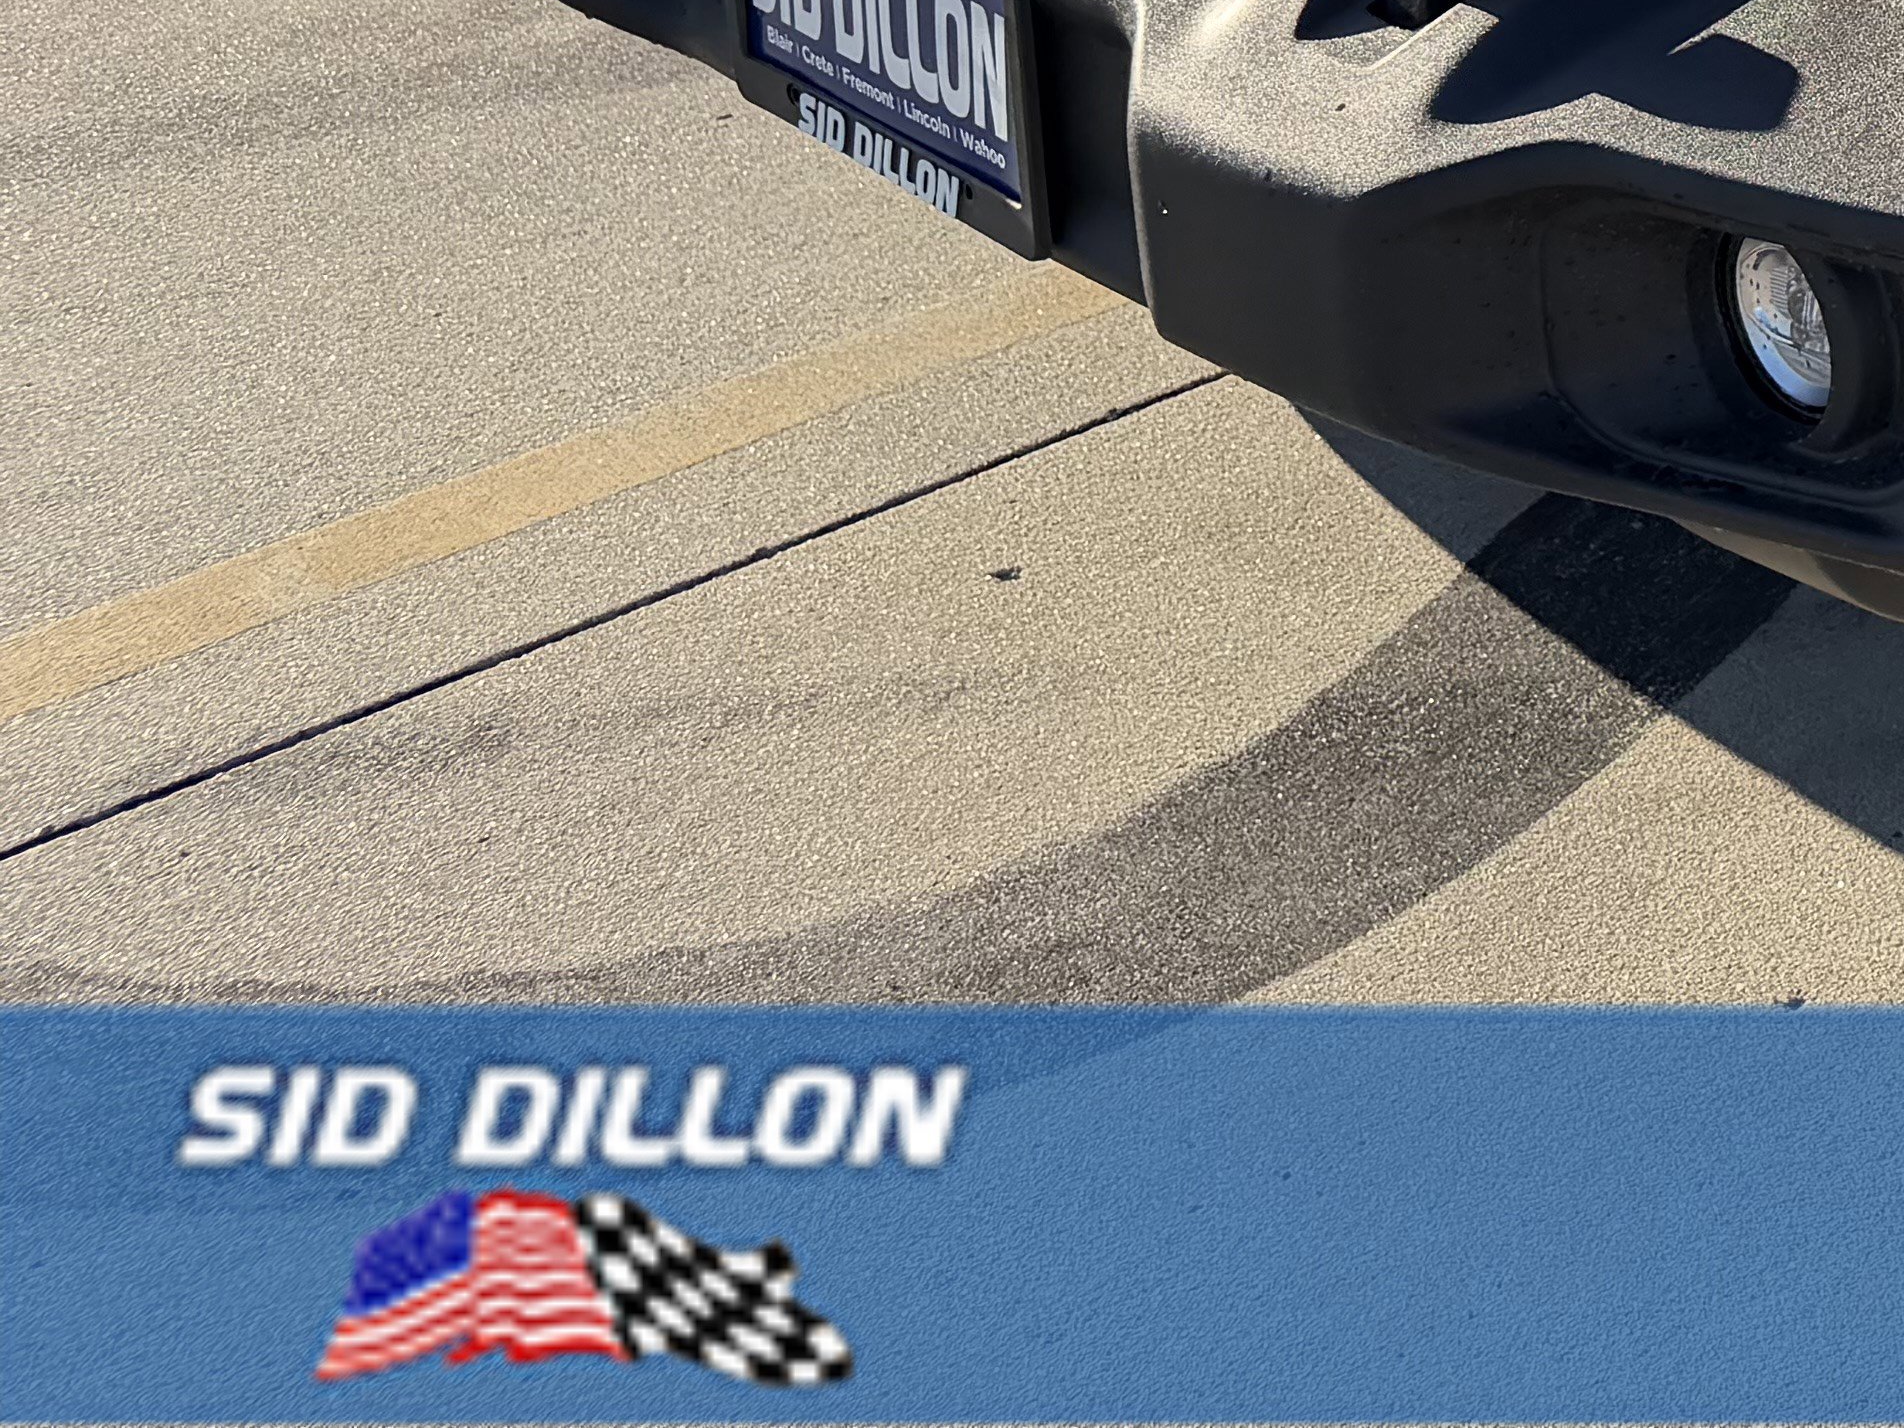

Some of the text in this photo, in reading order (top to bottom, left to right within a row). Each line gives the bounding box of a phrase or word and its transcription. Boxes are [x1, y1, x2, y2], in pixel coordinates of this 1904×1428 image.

[766, 25, 1006, 169] Blair Crete Fremont Lincoln Wahoo
[798, 92, 960, 219] SID DILLON
